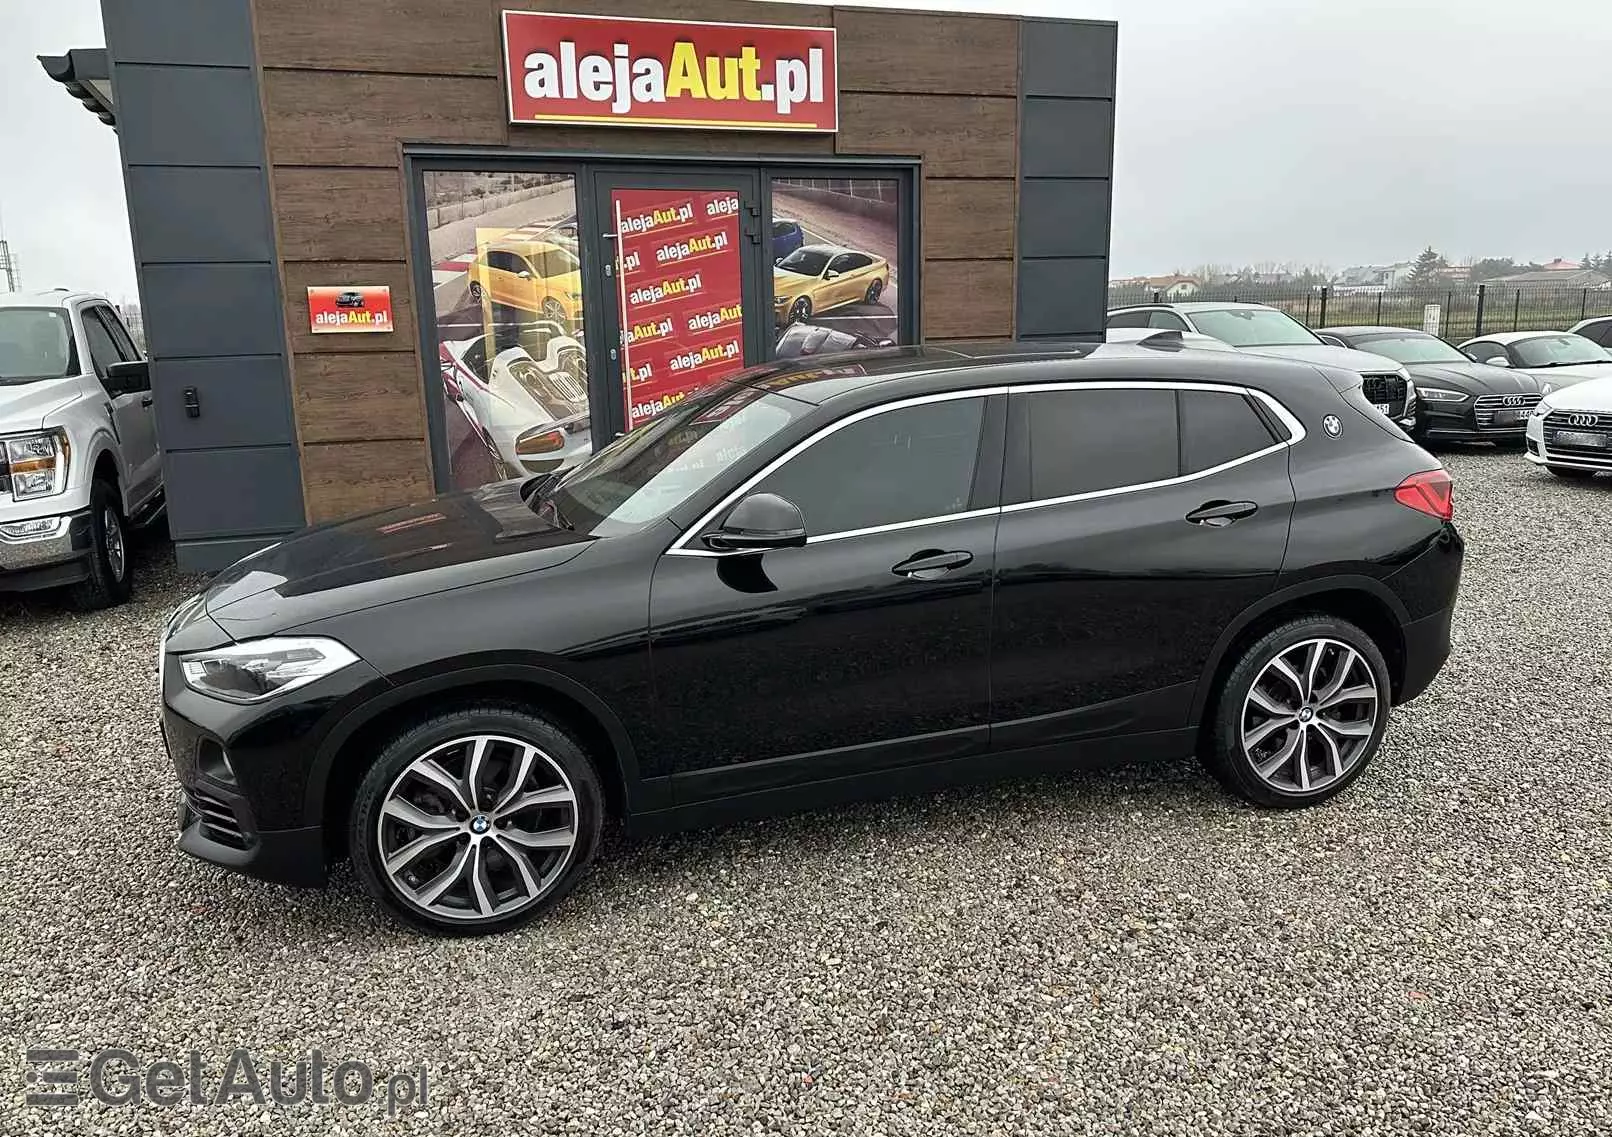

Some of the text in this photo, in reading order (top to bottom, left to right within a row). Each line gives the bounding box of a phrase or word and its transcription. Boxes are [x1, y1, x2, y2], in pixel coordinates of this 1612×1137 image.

[523, 41, 824, 114] alejaAut.pl
[621, 203, 694, 233] alejaAut.pl
[656, 232, 728, 262] alejaAut.pl
[630, 274, 702, 304] alejaAut.pl
[315, 310, 388, 326] alejaAut.pl
[670, 340, 739, 370] alejaAut.pl
